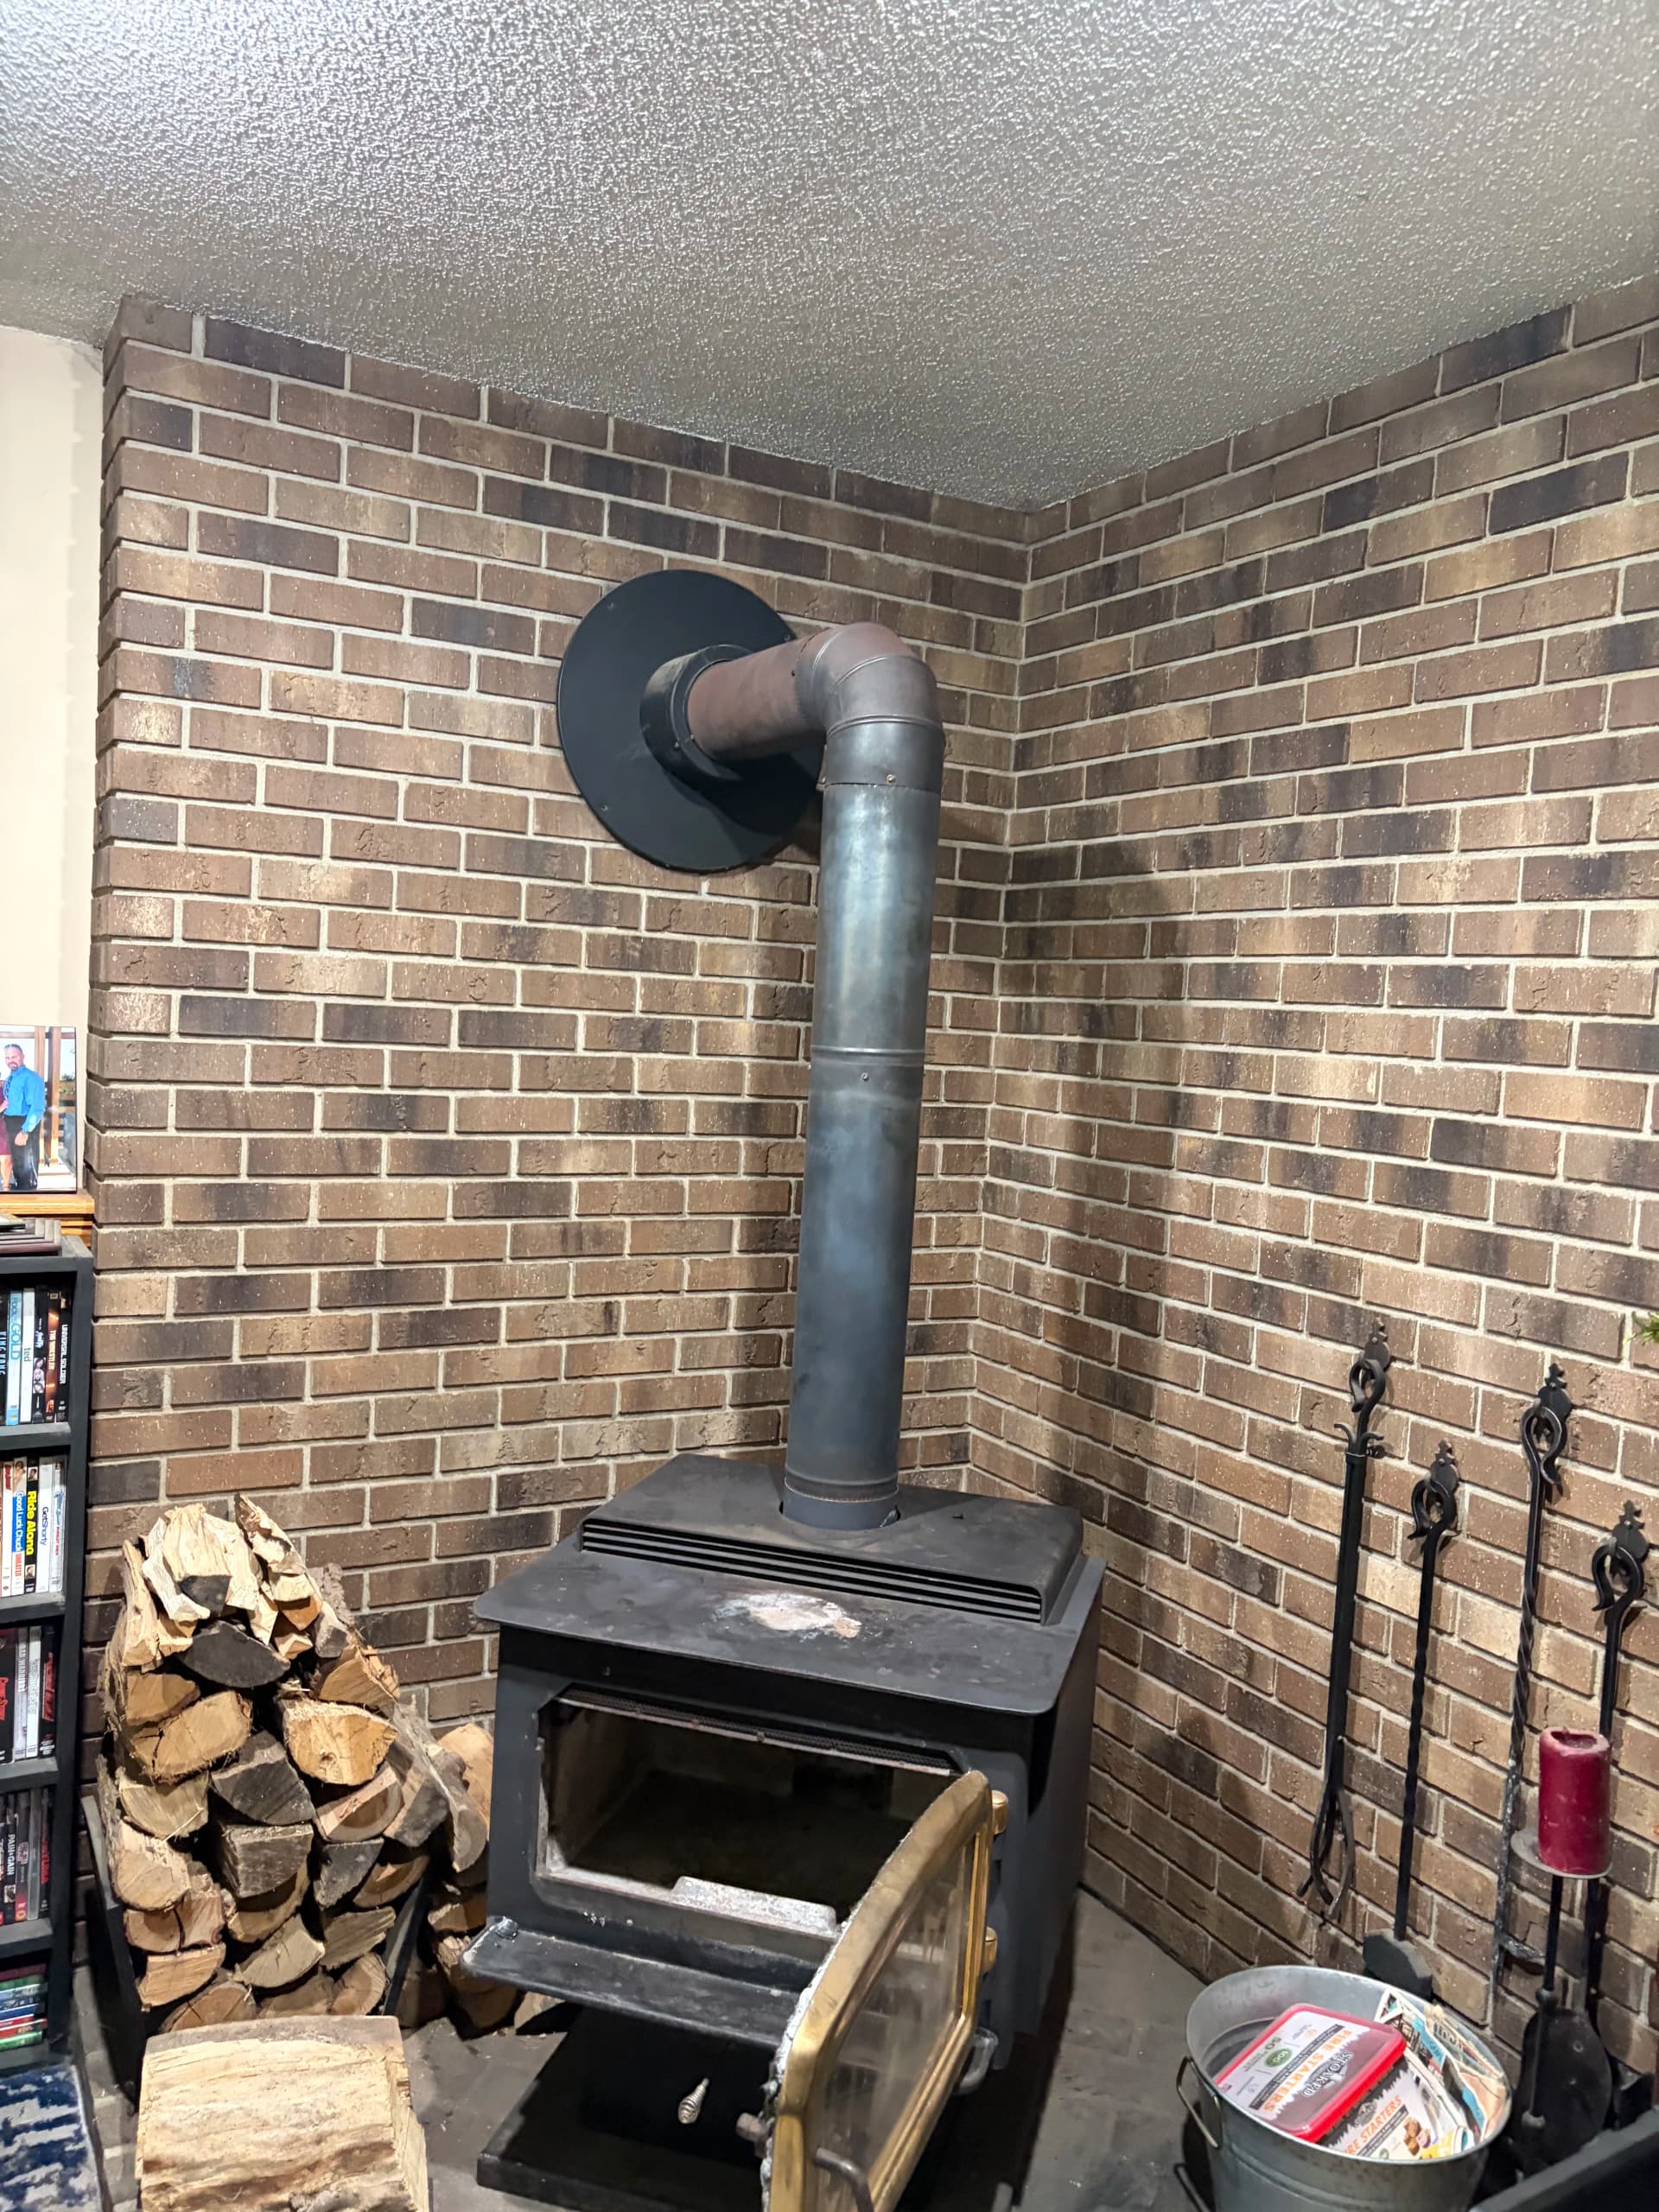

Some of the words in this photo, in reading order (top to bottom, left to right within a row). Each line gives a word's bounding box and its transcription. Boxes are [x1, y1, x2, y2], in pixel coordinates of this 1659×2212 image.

[10, 1324, 22, 1360] GOLD
[27, 1491, 37, 1519] Ride
[15, 1530, 23, 1552] Chuck
[26, 1521, 37, 1555] Along
[1323, 2029, 1352, 2052] FIRE
[1263, 2053, 1324, 2111] STARTERS
[1362, 2095, 1402, 2143] STARTERS
